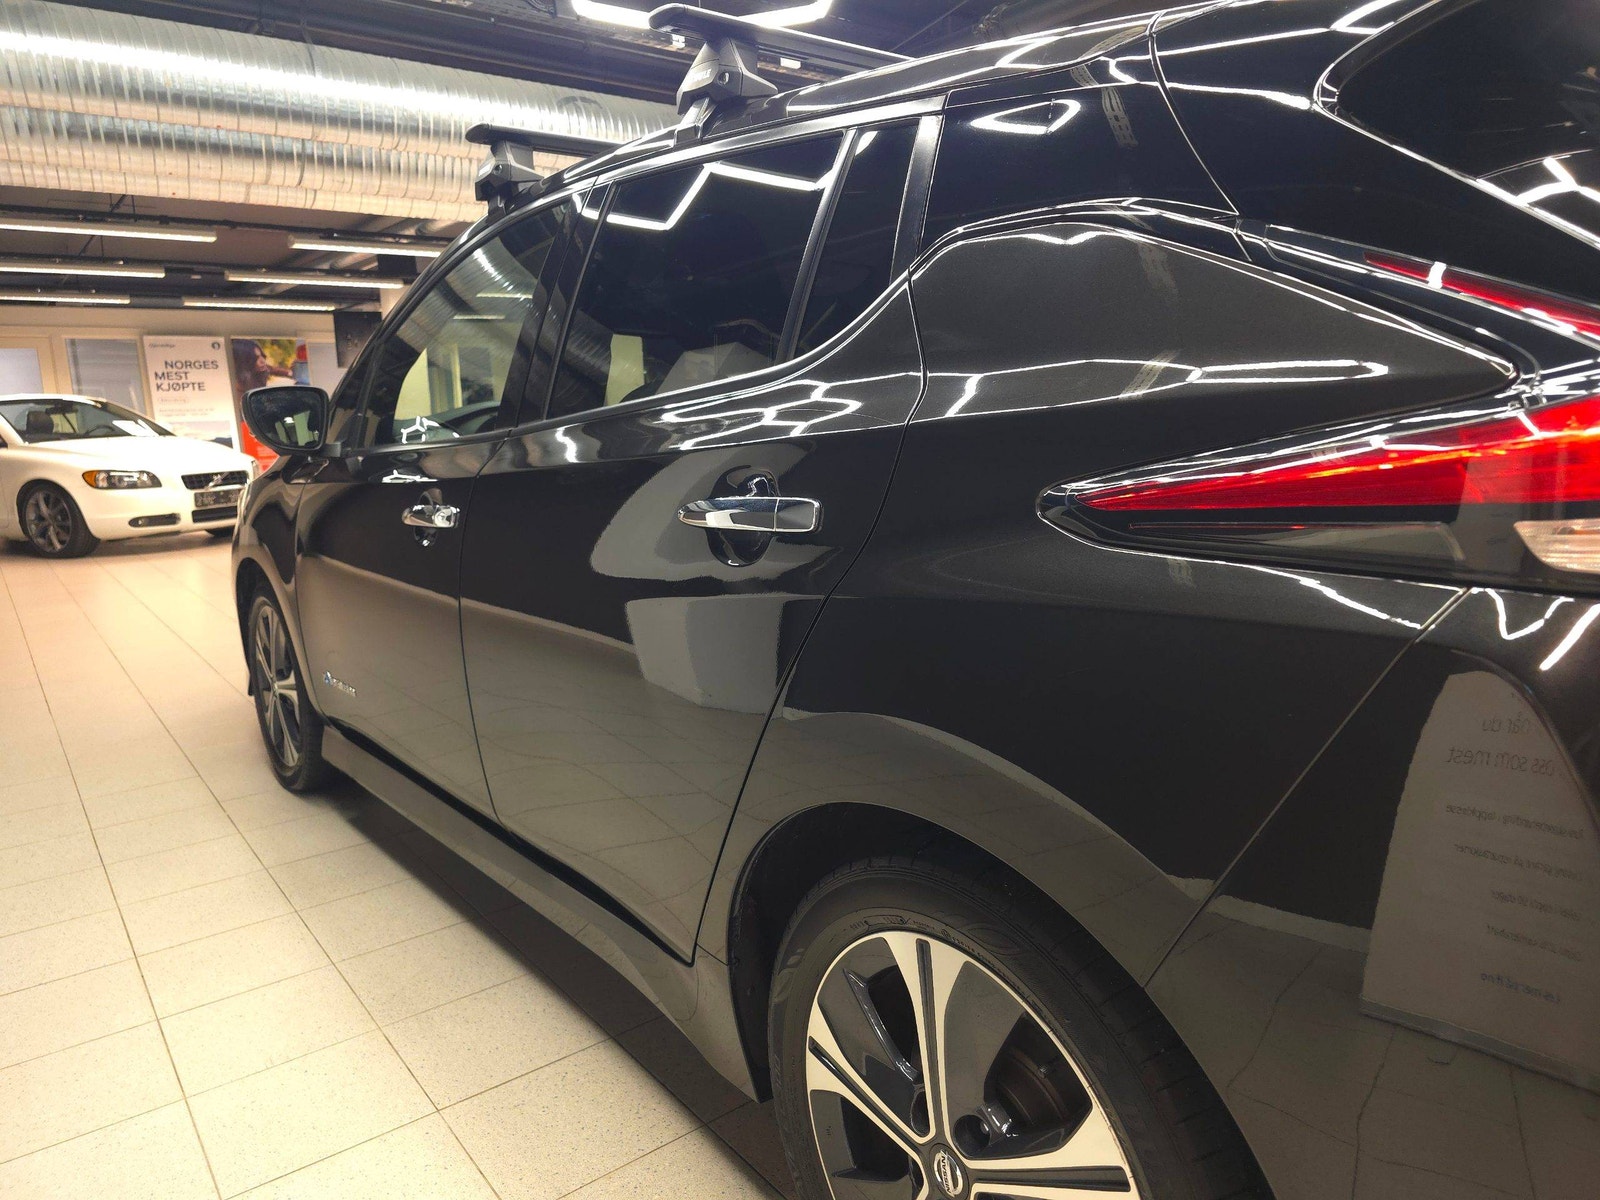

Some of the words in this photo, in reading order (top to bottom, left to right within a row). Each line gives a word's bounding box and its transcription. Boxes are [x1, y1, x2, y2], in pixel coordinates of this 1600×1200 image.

[164, 360, 219, 370] NORGES
[154, 371, 189, 381] MEST
[156, 382, 206, 392] KJØPTE
[941, 1155, 952, 1194] NISSAN
